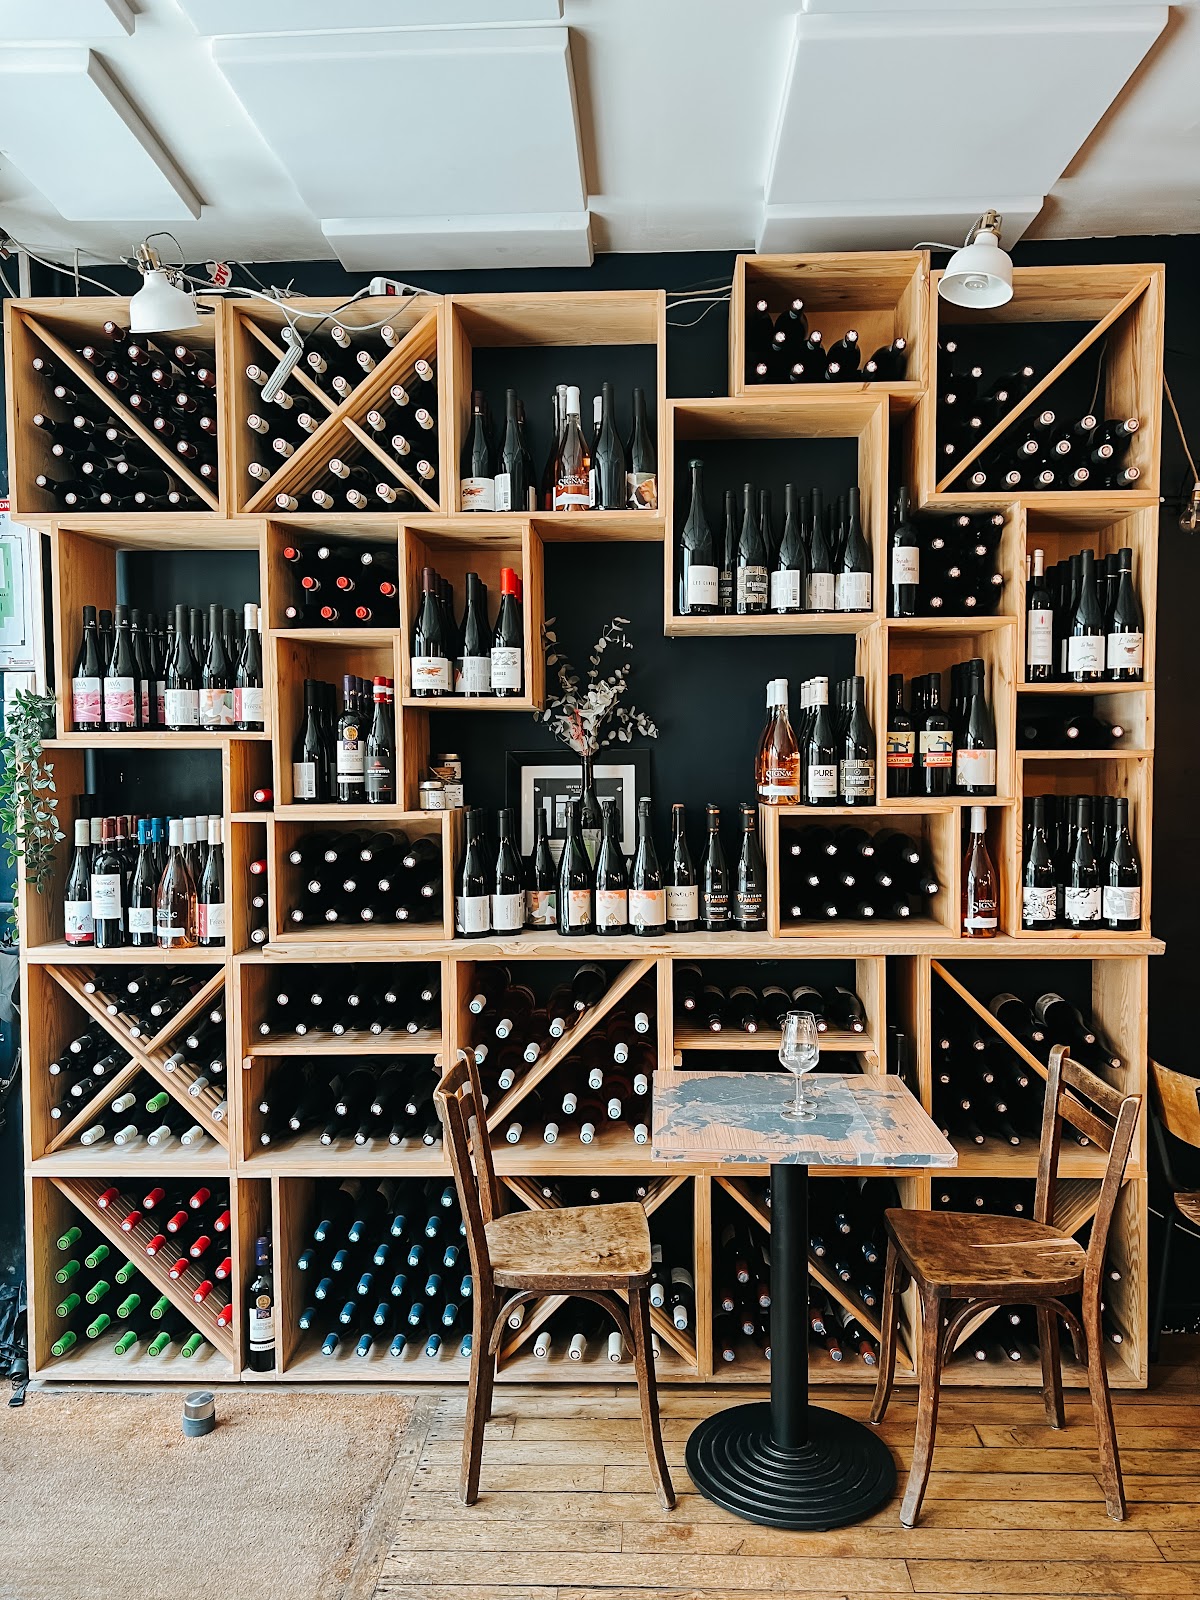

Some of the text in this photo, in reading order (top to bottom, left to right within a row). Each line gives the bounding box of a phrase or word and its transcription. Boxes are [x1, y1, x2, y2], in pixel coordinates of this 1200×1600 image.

[558, 477, 587, 490] SIGNAC
[765, 770, 794, 782] SIGNAC
[814, 769, 834, 777] PURE
